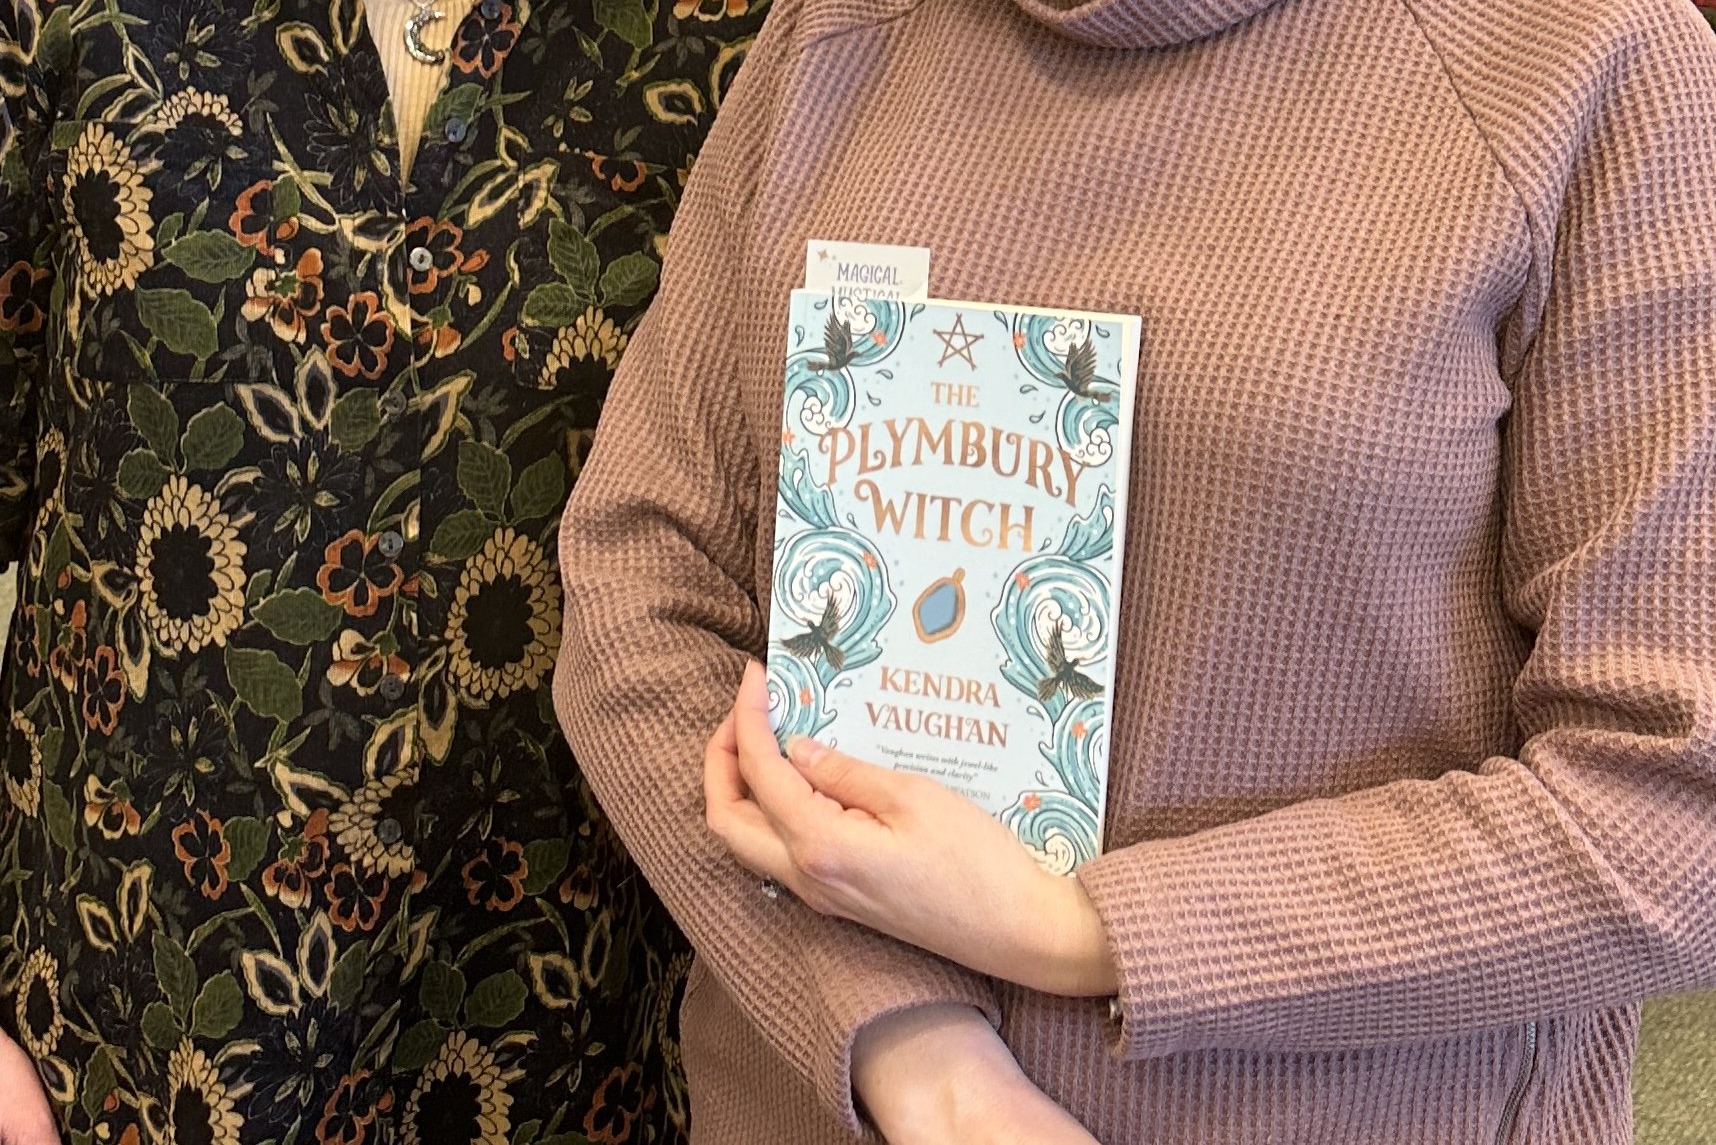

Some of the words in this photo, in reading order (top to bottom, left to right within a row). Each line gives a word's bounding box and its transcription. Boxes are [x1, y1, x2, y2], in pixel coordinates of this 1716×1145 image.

[931, 381, 980, 408] THE
[818, 417, 1090, 508] PLYMBURY
[854, 478, 1035, 553] WITCH
[880, 665, 1001, 708] KENDRA
[864, 702, 1009, 749] VAUGHAN
[893, 761, 929, 773] precision
[930, 767, 947, 776] and
[940, 756, 960, 766] with
